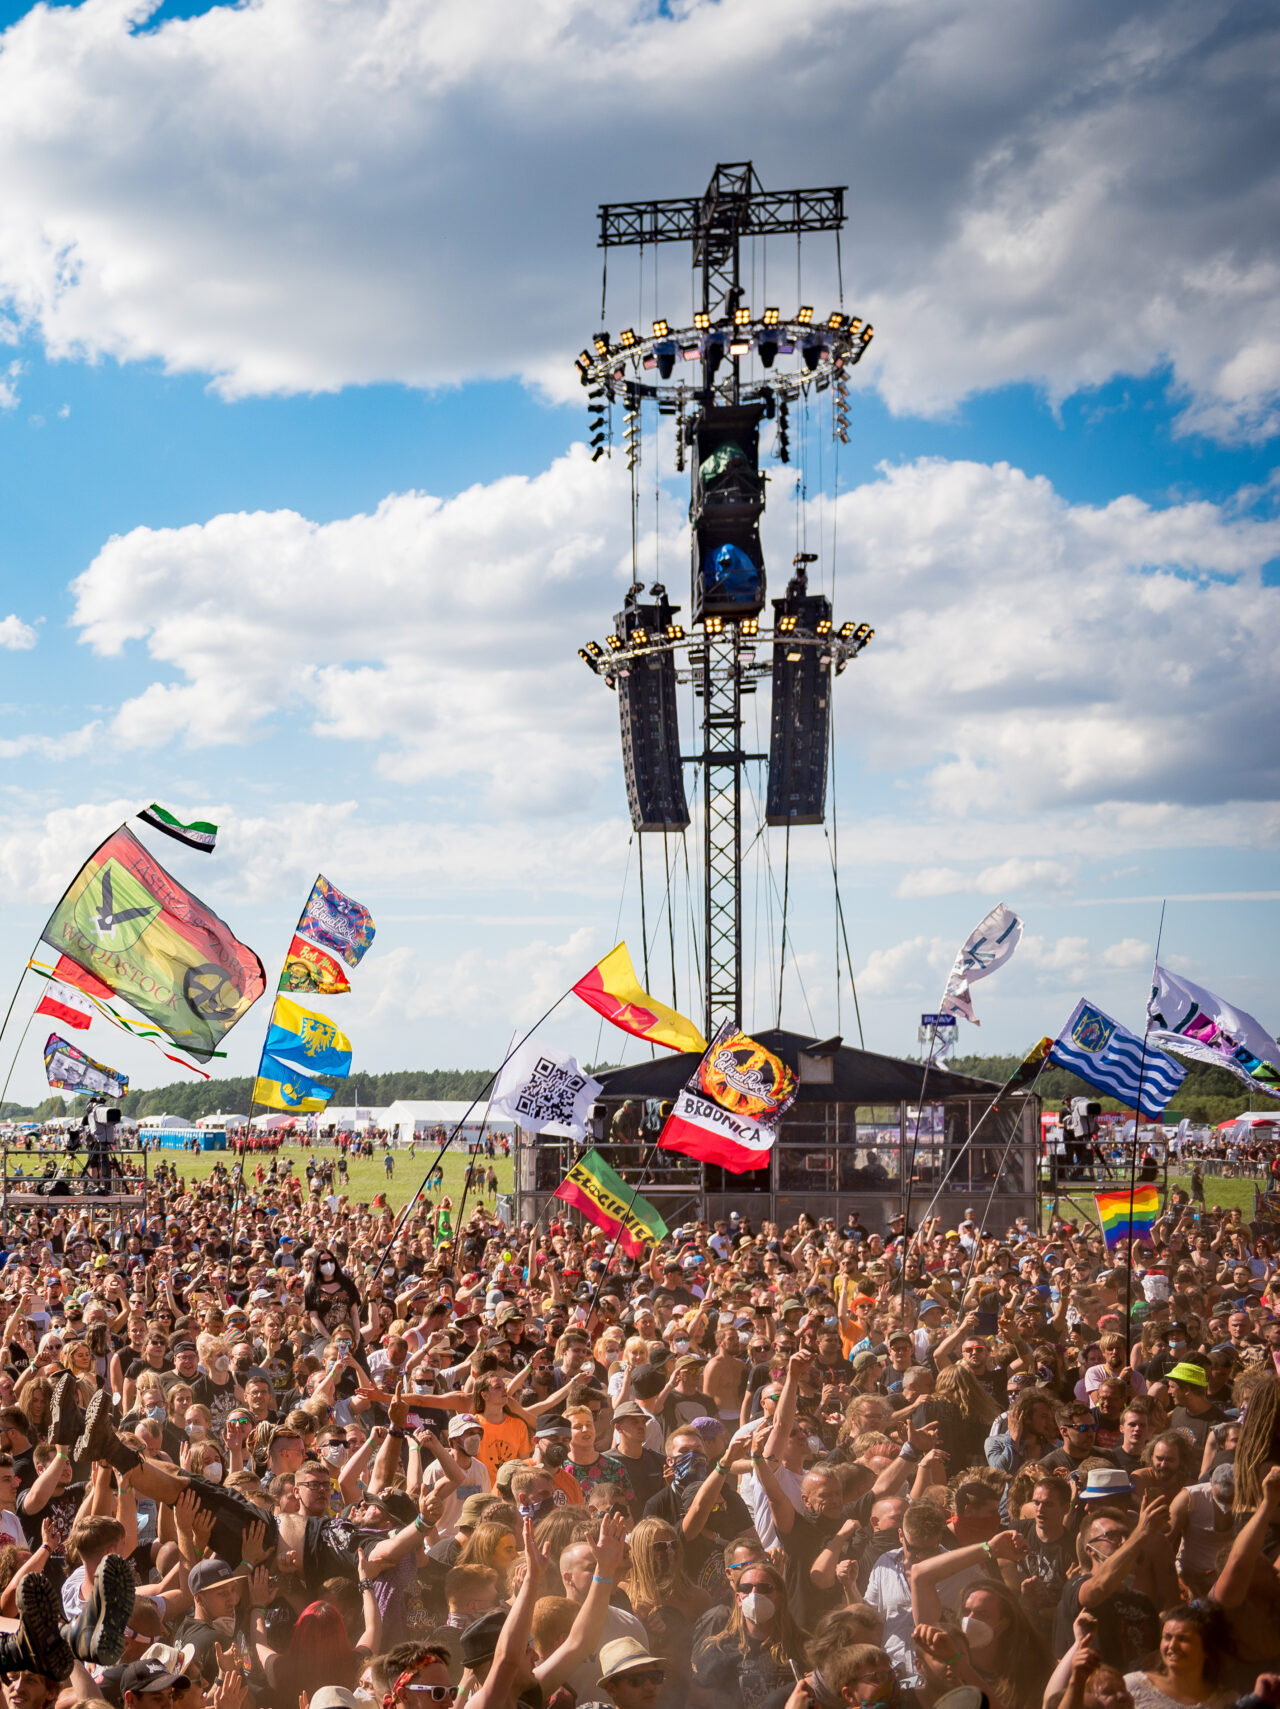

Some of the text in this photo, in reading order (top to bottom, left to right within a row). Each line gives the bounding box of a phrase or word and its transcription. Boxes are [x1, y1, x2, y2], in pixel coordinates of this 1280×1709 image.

[61, 920, 181, 1012] WOODSTOCK
[299, 945, 318, 962] Bob
[924, 1016, 953, 1024] PLAY
[684, 1098, 761, 1142] BRODNICA
